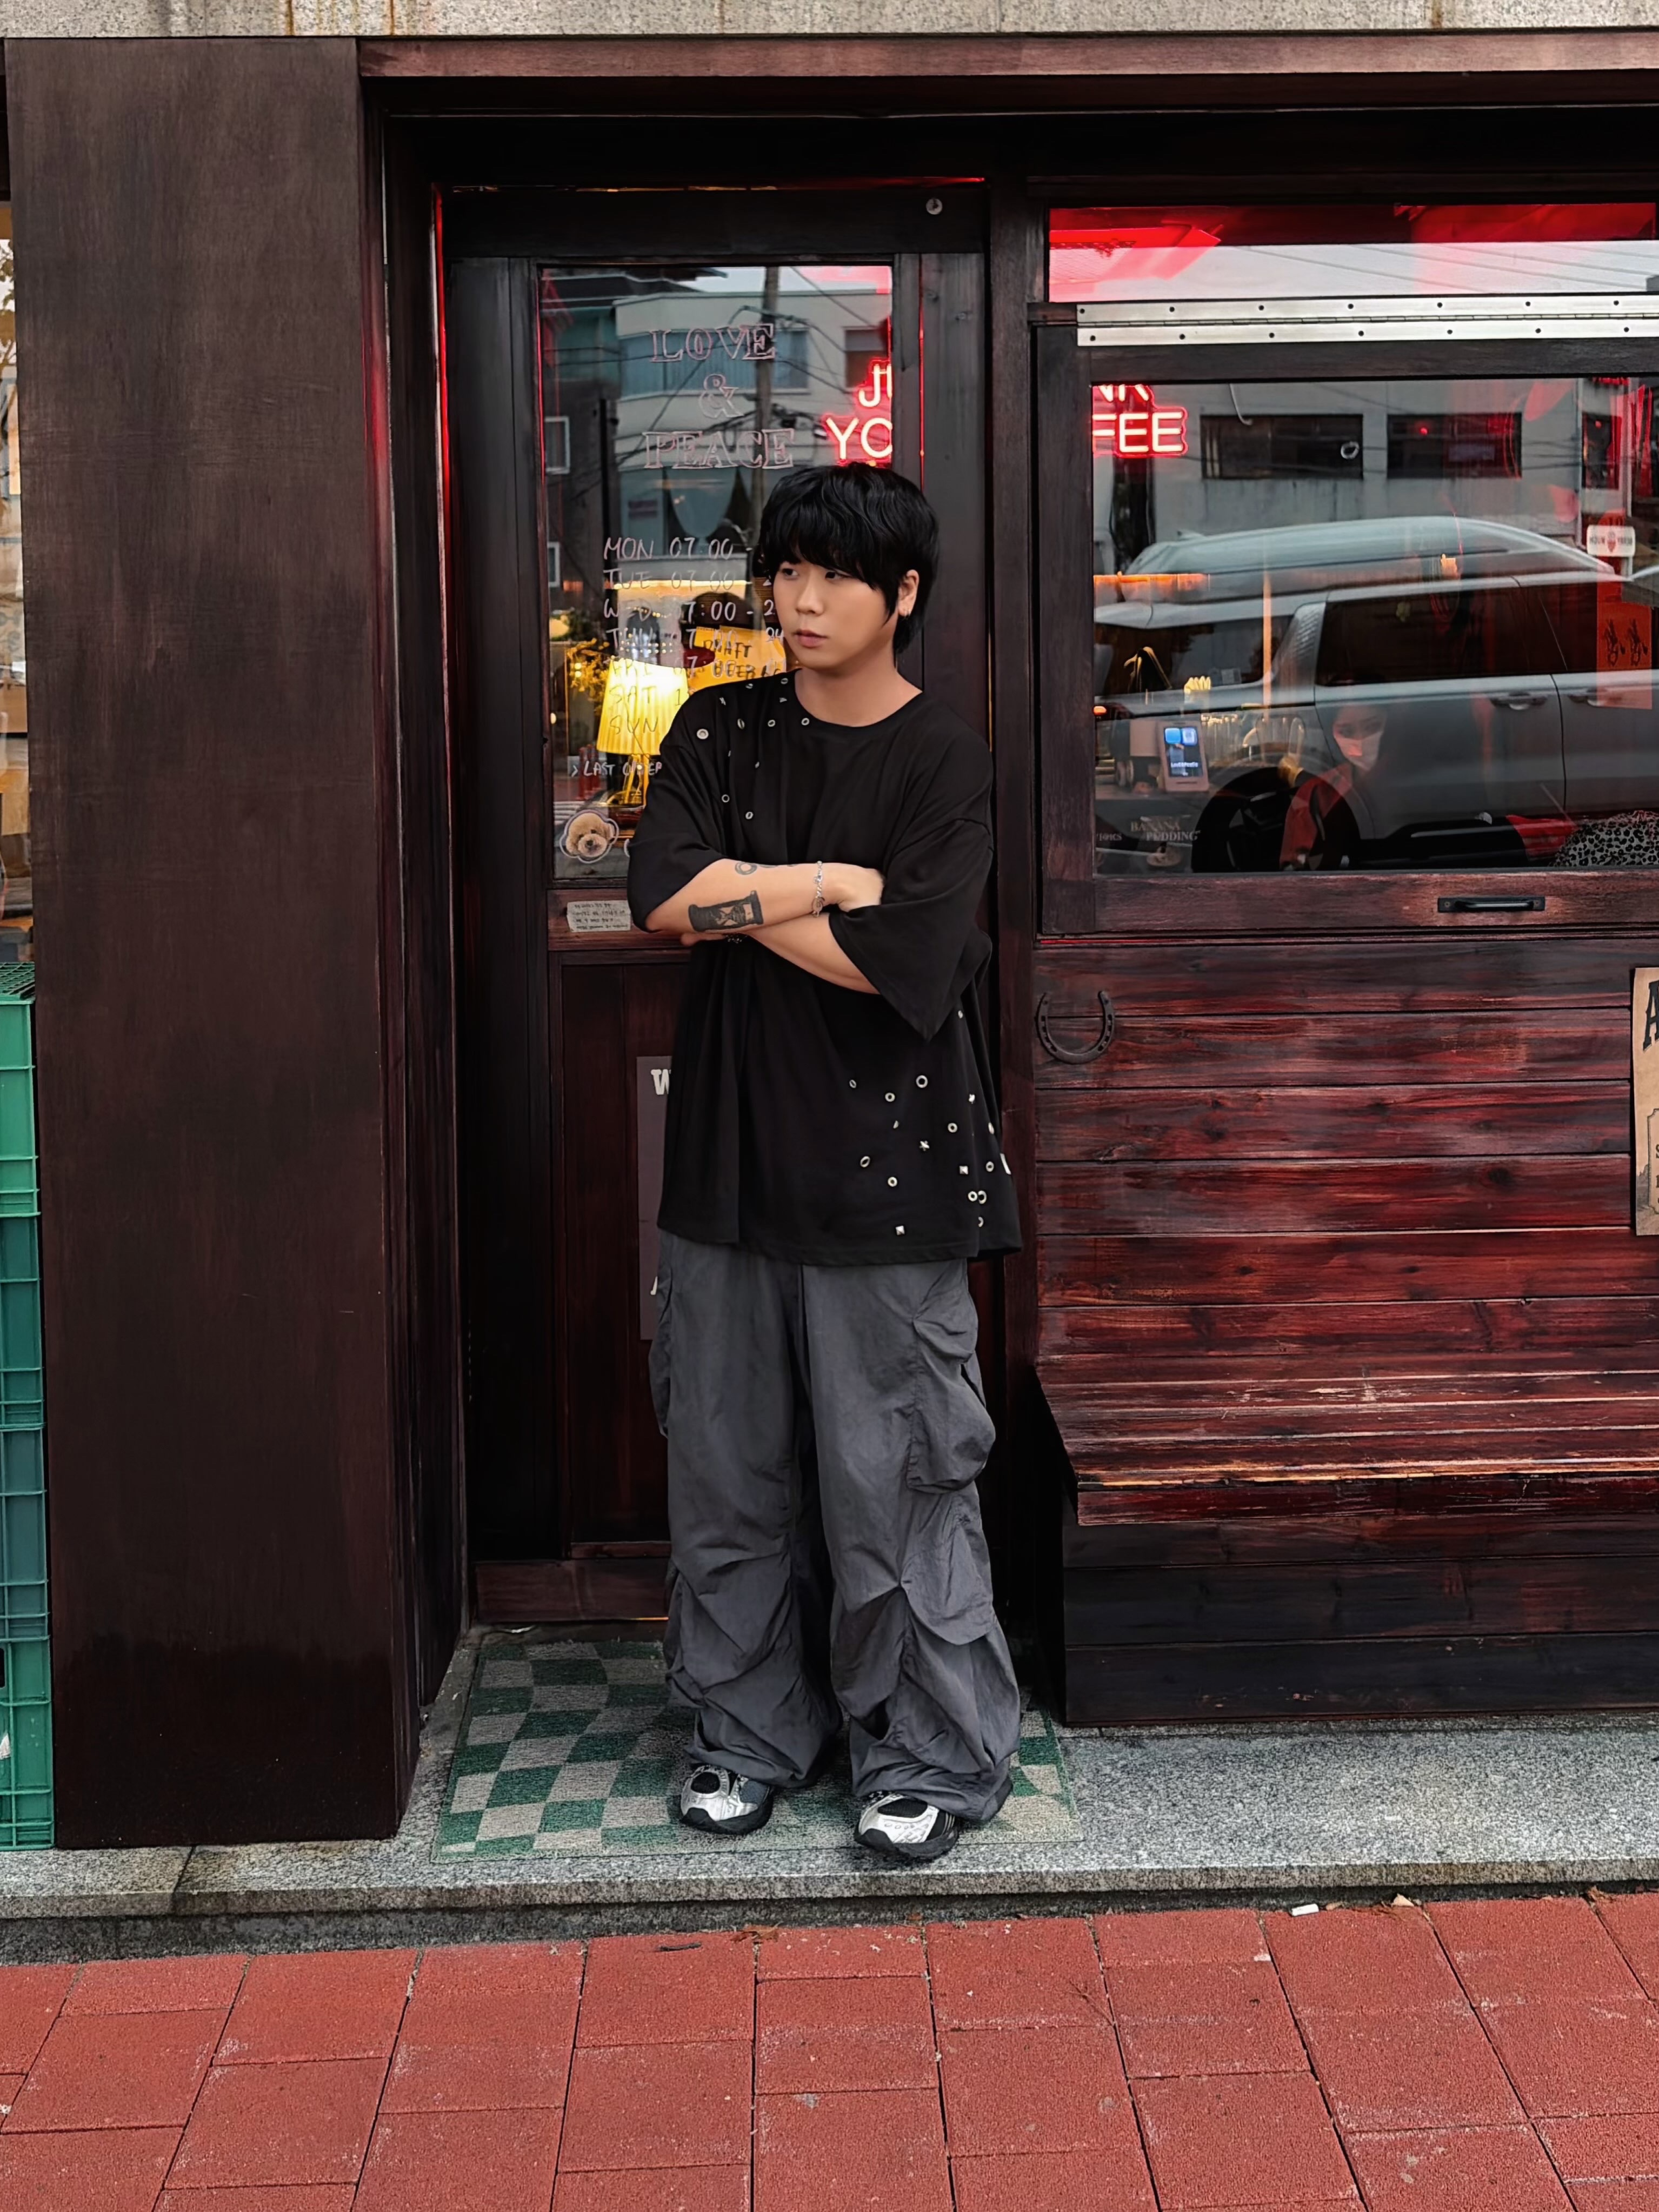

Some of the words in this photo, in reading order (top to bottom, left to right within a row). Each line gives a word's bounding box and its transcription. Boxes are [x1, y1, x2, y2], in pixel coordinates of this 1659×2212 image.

[651, 324, 775, 362] LOVE
[699, 373, 744, 418] &
[642, 428, 795, 469] PEACE
[604, 537, 654, 560] MON
[603, 568, 652, 589] TUE
[609, 685, 657, 705] SAT
[609, 715, 658, 736] SUN
[583, 760, 616, 777] LAST
